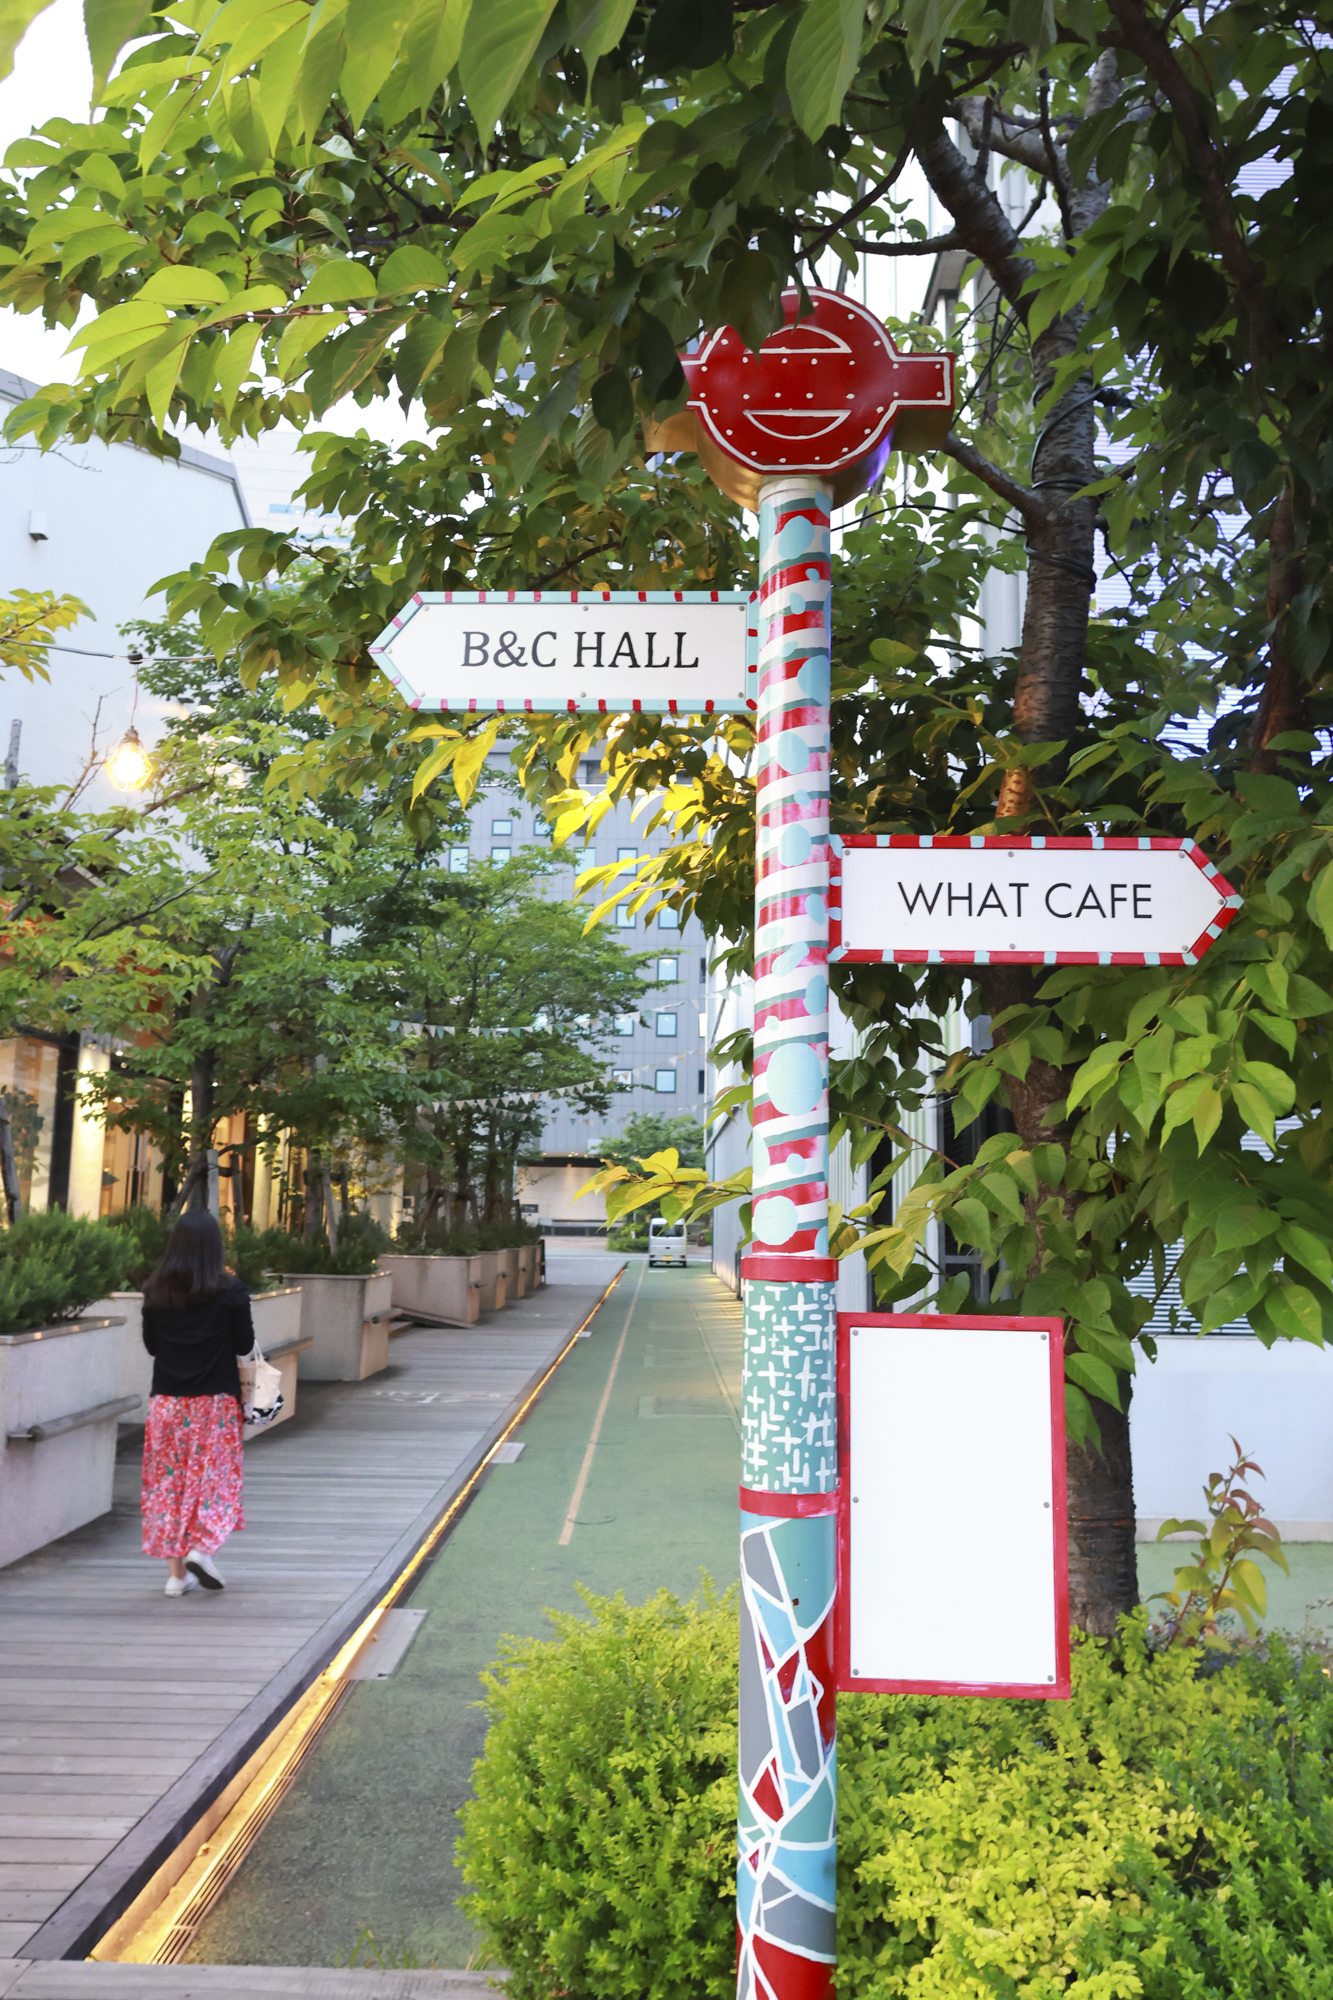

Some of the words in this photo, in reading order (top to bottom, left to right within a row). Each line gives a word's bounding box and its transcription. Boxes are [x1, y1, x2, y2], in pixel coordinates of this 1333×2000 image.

[461, 630, 557, 668] B&C
[573, 631, 699, 669] HALL
[897, 881, 1030, 918] WHAT
[1044, 882, 1153, 919] CAFE
